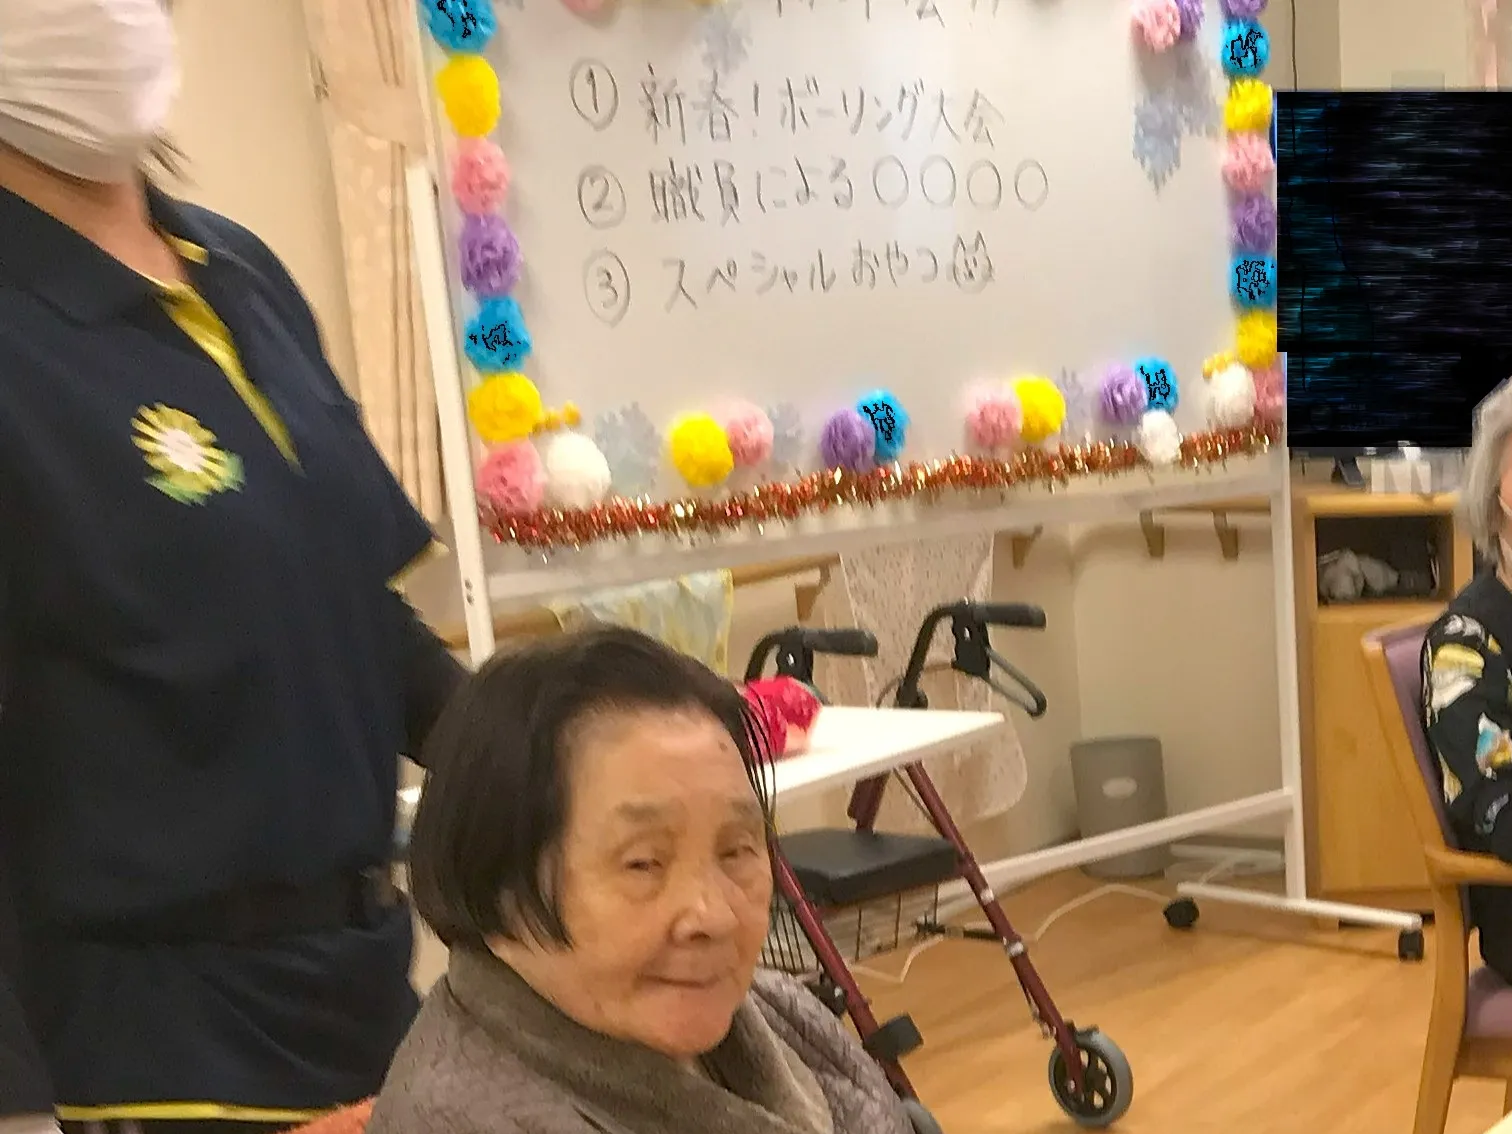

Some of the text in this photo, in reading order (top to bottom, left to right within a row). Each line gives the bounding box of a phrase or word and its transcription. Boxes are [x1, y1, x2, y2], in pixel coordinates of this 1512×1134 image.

[661, 238, 939, 311] スペシャルおやつ
